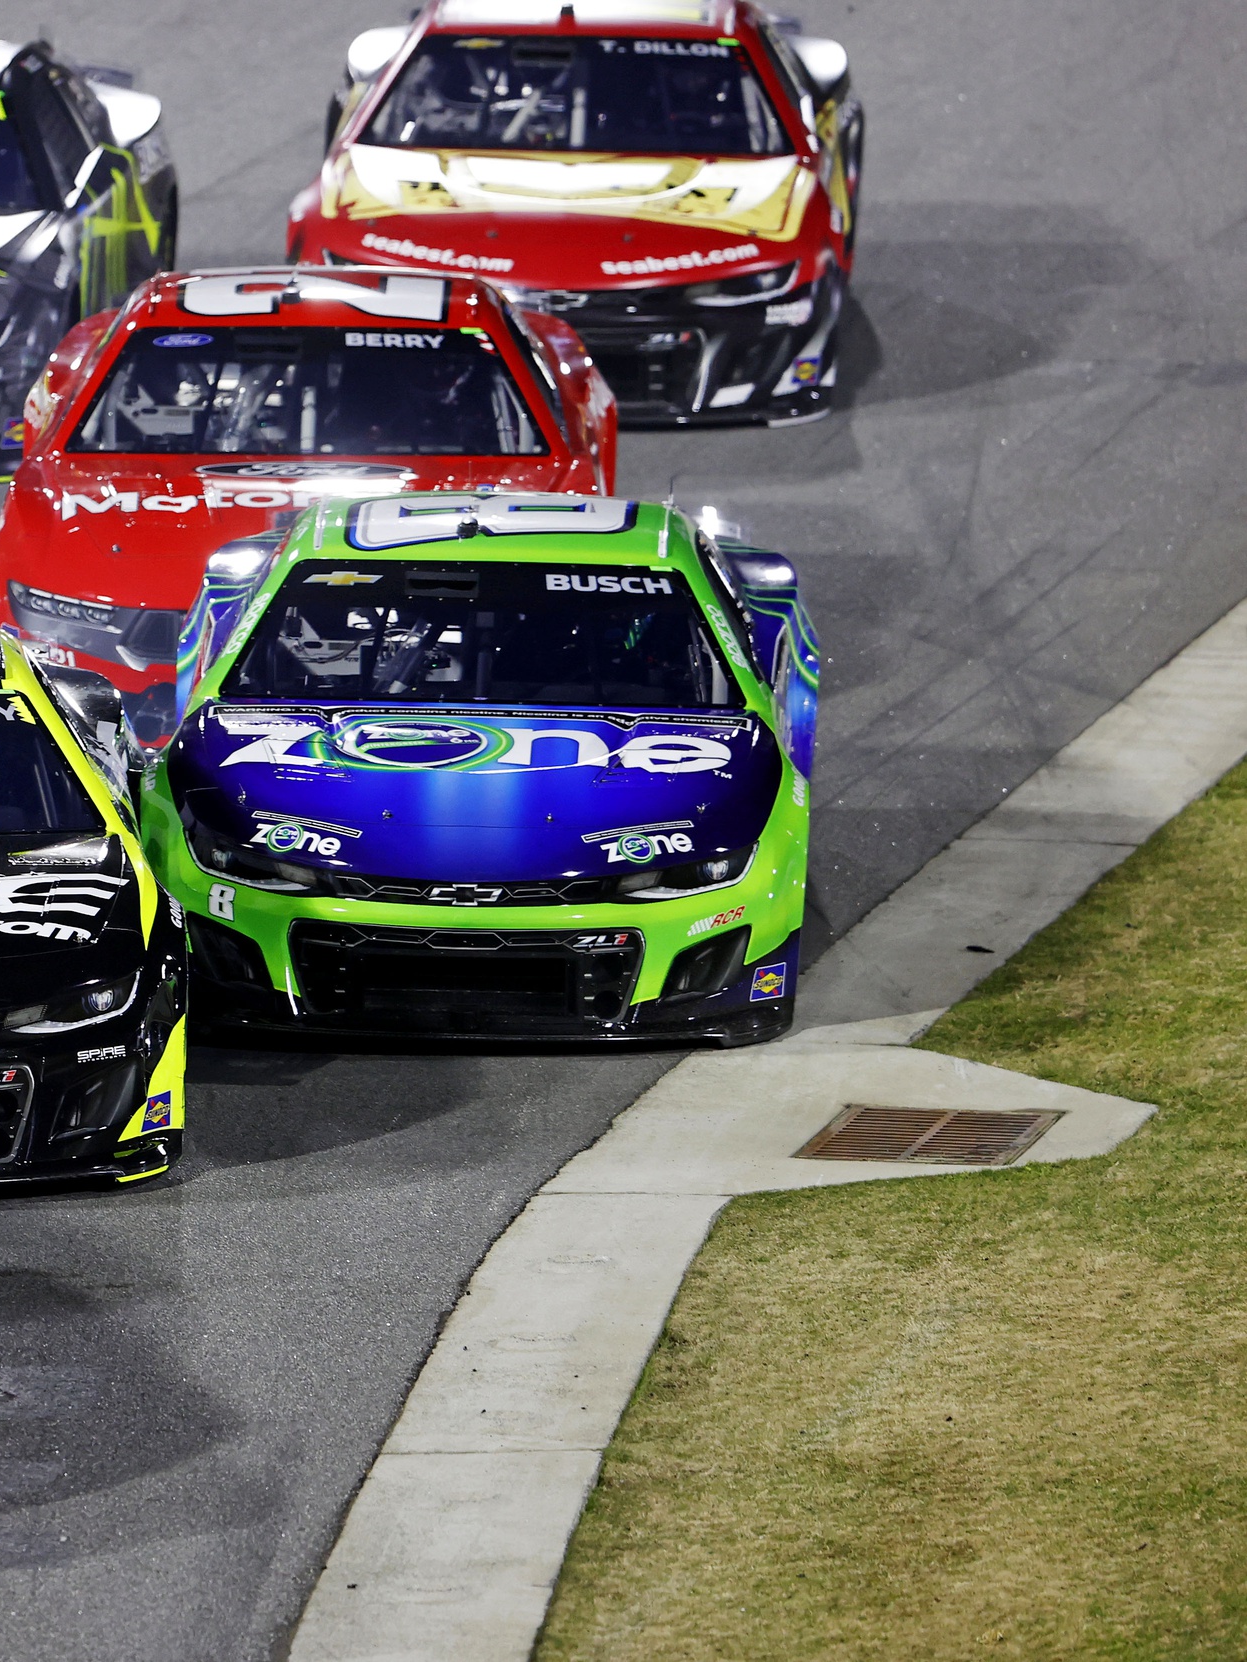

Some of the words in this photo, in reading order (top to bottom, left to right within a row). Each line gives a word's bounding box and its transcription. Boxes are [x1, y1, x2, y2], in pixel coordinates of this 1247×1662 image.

[598, 39, 626, 53] T.
[634, 40, 730, 58] DILLON
[361, 233, 514, 273] seabest.com
[600, 243, 759, 276] seabest.com
[344, 332, 445, 349] BERRY
[545, 573, 674, 595] BUSCH
[209, 882, 236, 922] 8
[709, 905, 746, 929] RCR
[572, 933, 629, 948] ZL1
